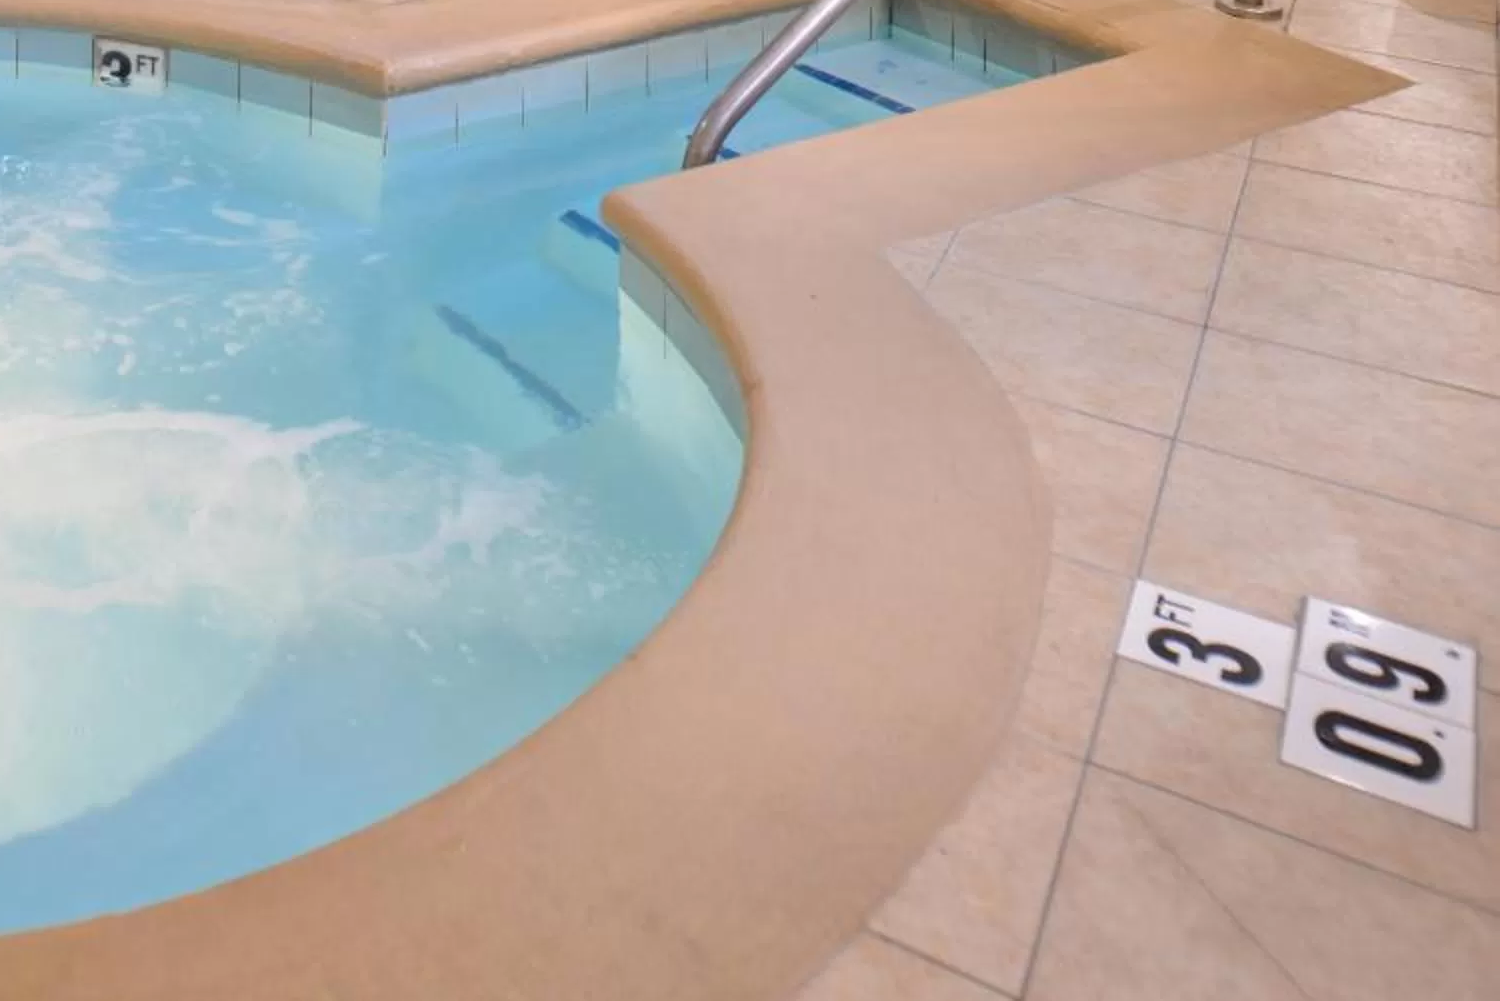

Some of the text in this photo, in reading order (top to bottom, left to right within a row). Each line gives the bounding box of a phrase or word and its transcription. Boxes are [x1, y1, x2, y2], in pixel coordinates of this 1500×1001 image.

[136, 54, 160, 76] FT
[1146, 593, 1262, 687] 3 FT
